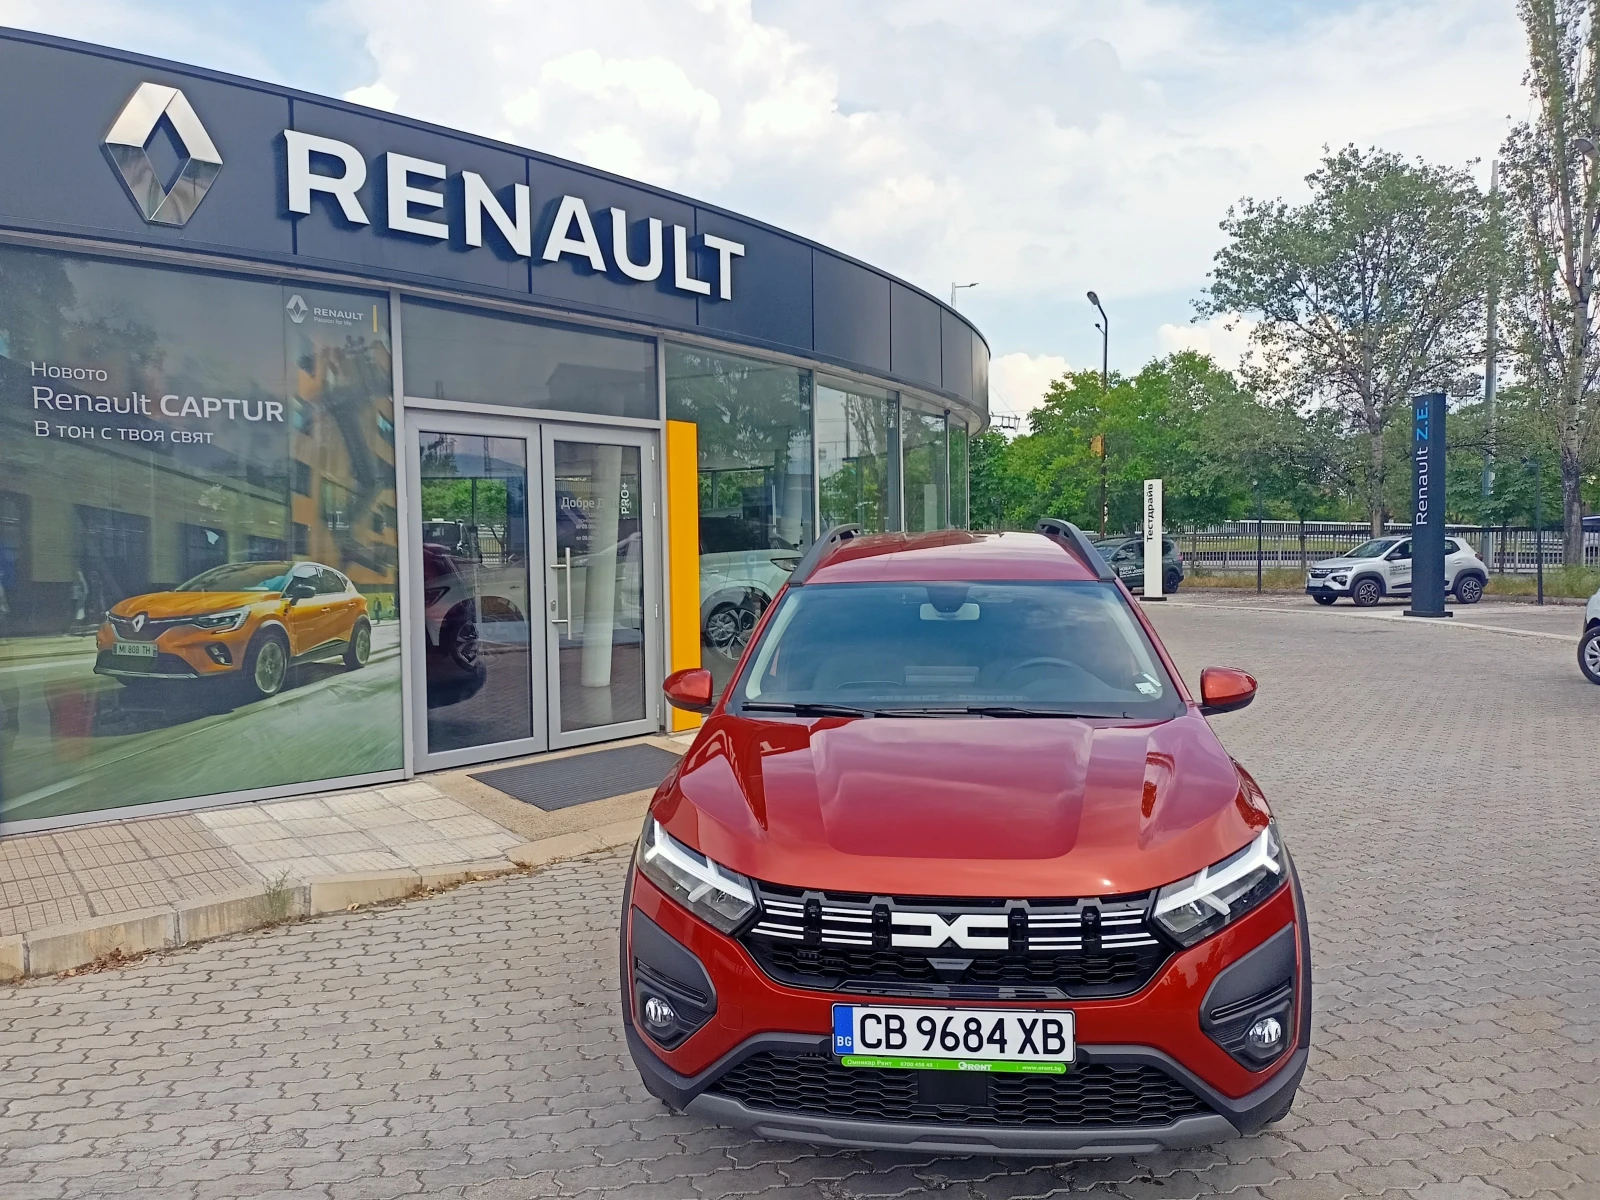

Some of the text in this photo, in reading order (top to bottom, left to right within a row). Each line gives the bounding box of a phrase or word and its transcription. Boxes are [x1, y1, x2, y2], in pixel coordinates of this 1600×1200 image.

[283, 129, 746, 300] RENAULT
[313, 307, 364, 321] RENAULT
[313, 316, 335, 324] Passion
[30, 361, 108, 382] Новото
[32, 385, 284, 422] Renault CAPTUR
[34, 420, 214, 444] В тон с твоя свят
[1415, 400, 1429, 526] Renault Z.E.
[560, 496, 595, 510] Добре
[1146, 483, 1155, 543] Тестдрайв
[142, 645, 151, 655] TH
[836, 1013, 1066, 1055] BG CB 9684 XB
[847, 1059, 893, 1067] Омникар Рент
